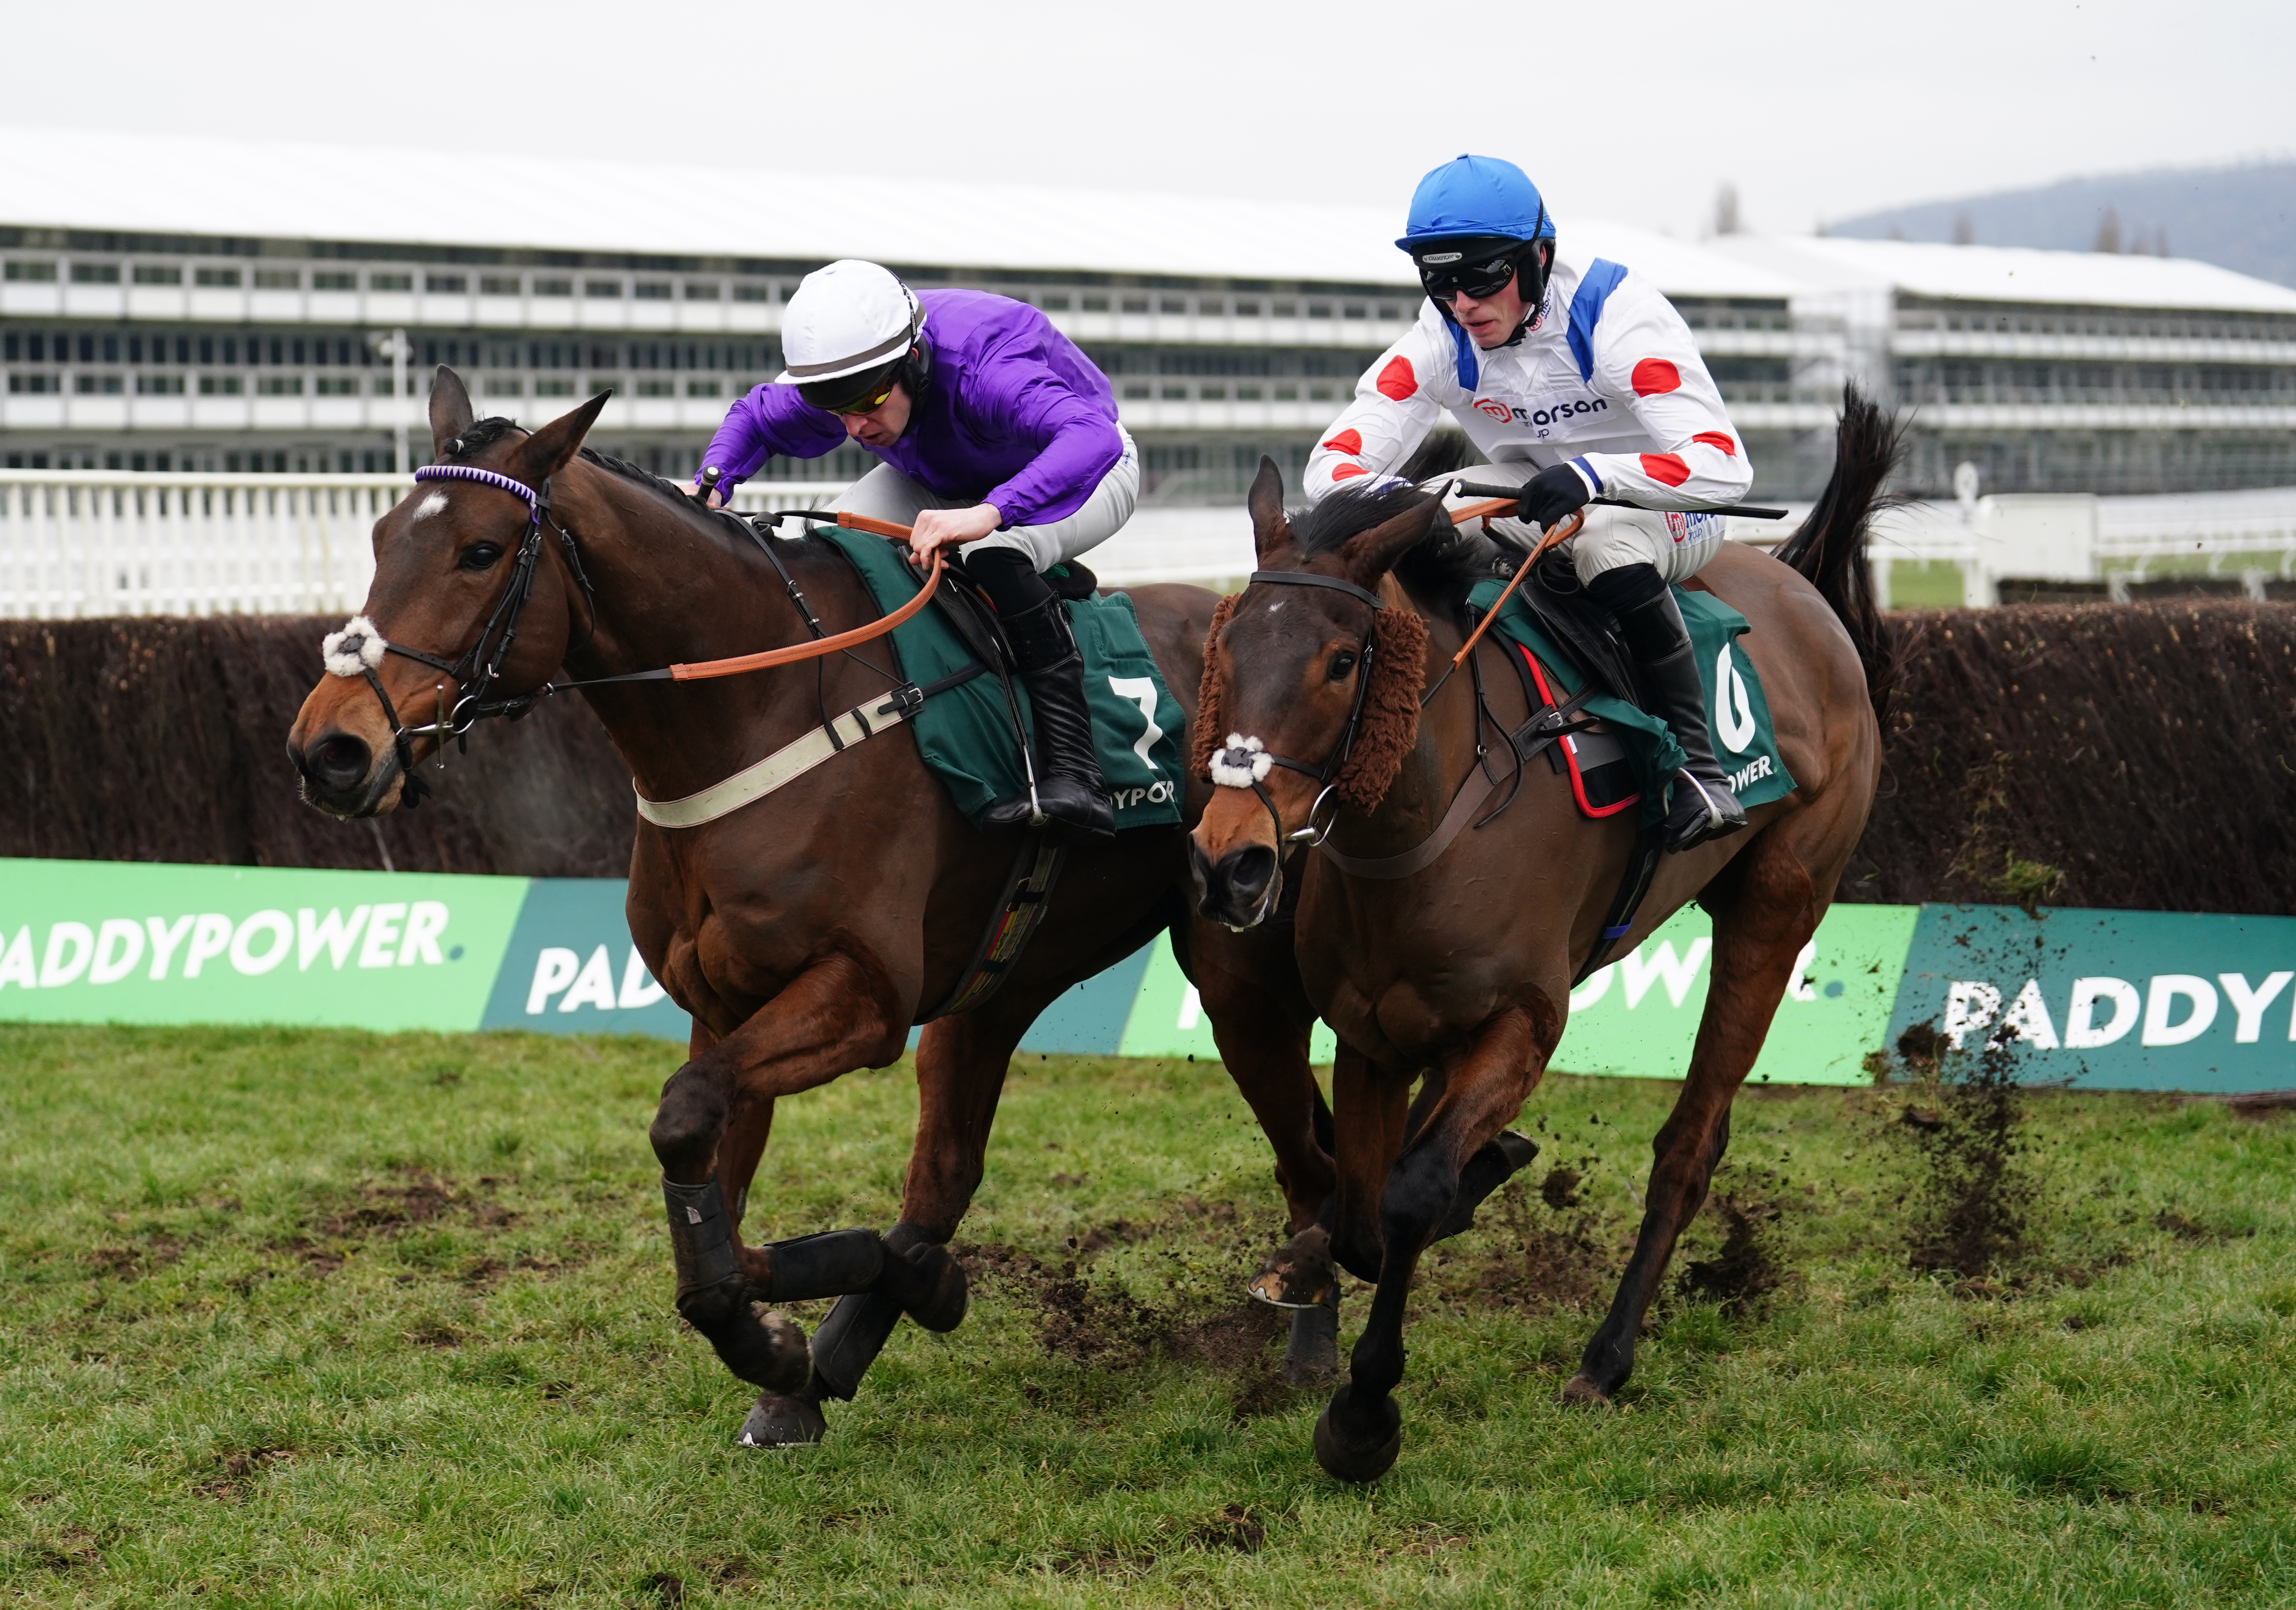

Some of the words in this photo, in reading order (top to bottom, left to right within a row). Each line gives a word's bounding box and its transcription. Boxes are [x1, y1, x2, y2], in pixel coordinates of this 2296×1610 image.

[1512, 398, 1608, 425] morson
[1108, 675, 1163, 769] 7
[1943, 971, 2296, 1051] PADDY
